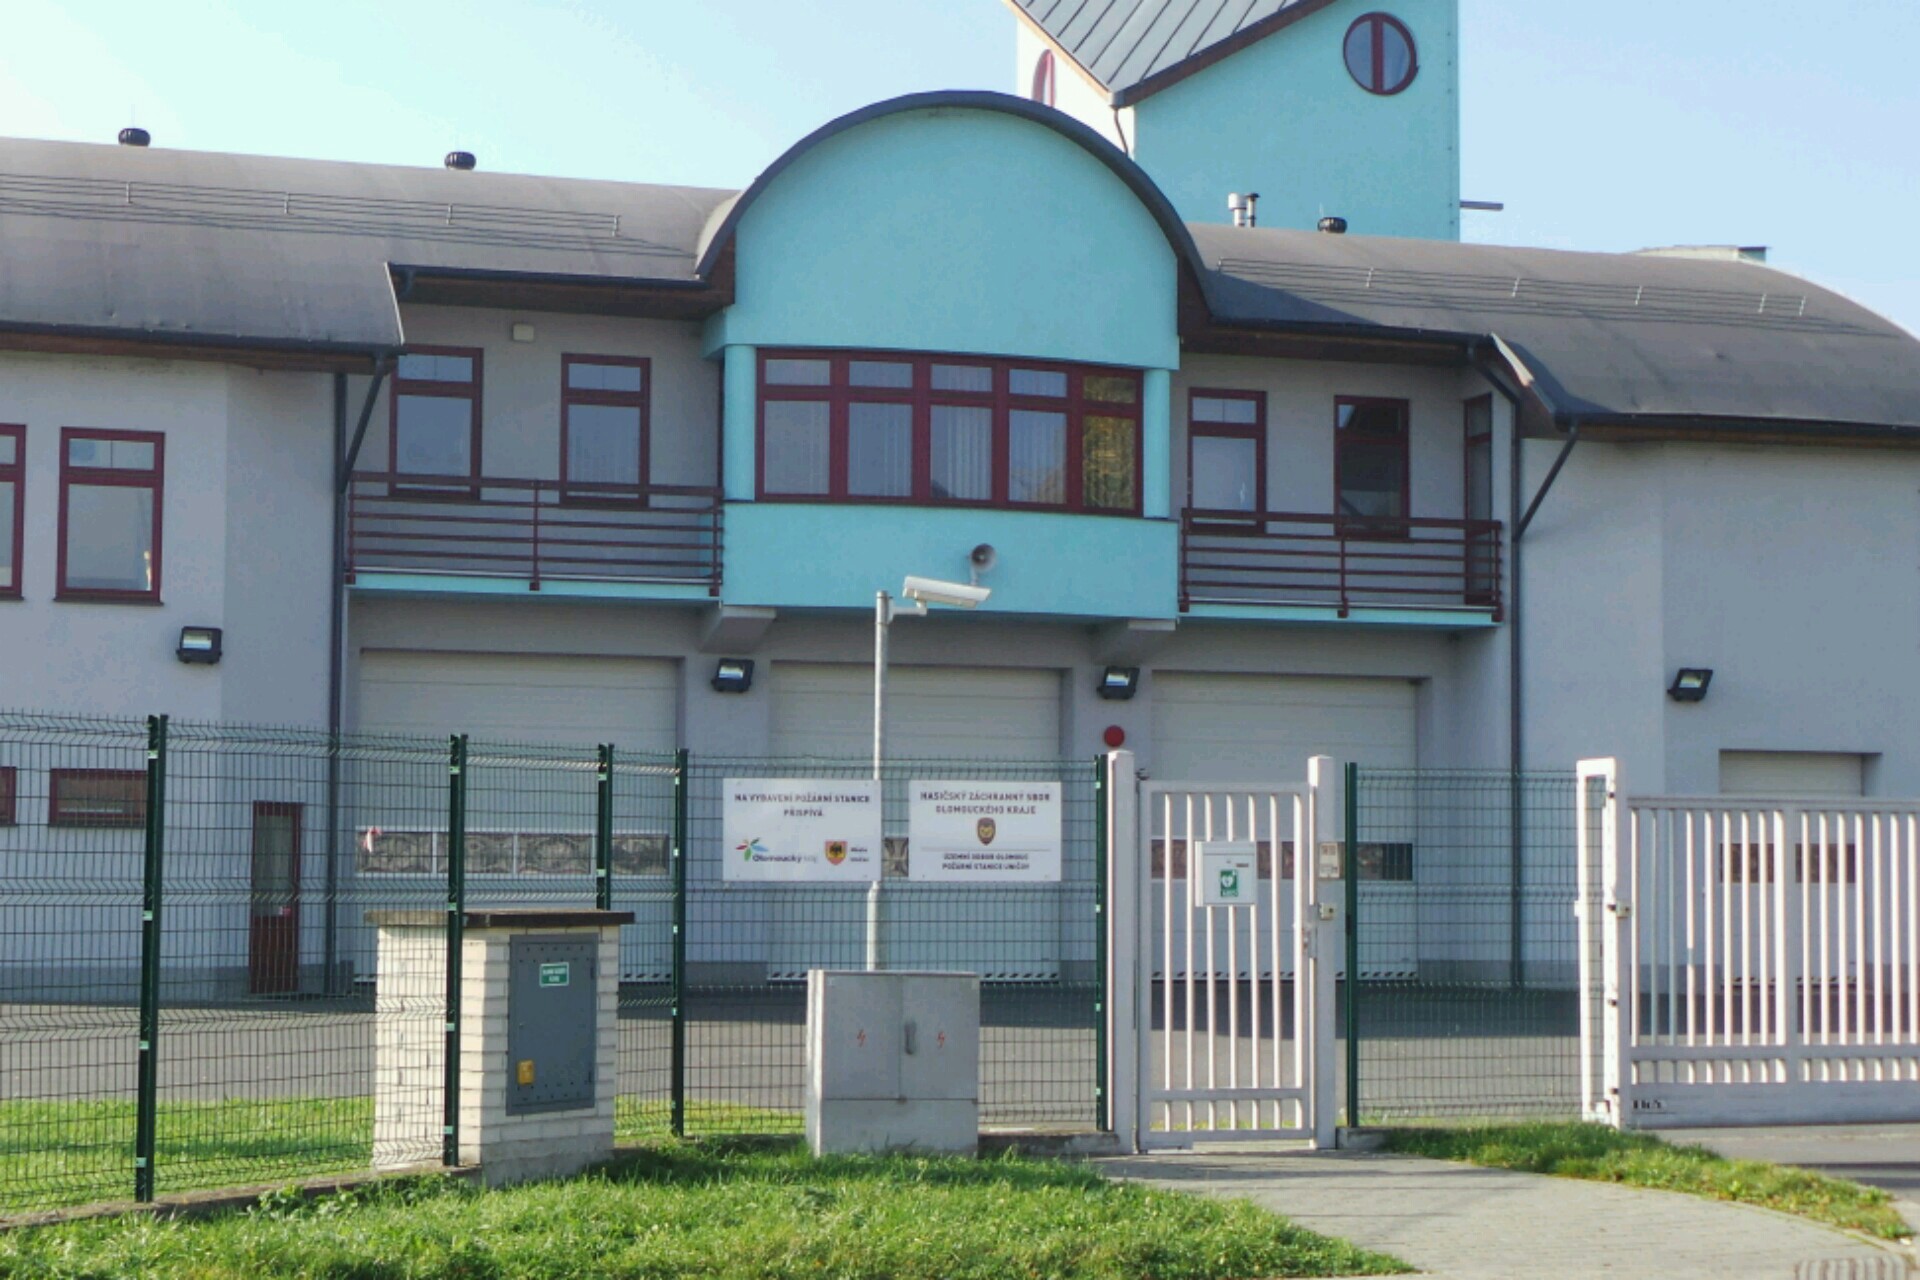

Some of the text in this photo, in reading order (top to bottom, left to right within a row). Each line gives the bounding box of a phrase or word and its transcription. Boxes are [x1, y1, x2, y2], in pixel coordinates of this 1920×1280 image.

[734, 793, 747, 803] NA
[835, 795, 870, 804] STANICE
[920, 790, 966, 801] HASIČSKÝ
[969, 790, 1024, 801] ZÁCHRANNÝ
[936, 804, 1036, 814] OLOMOUCKÉHO KRAJE
